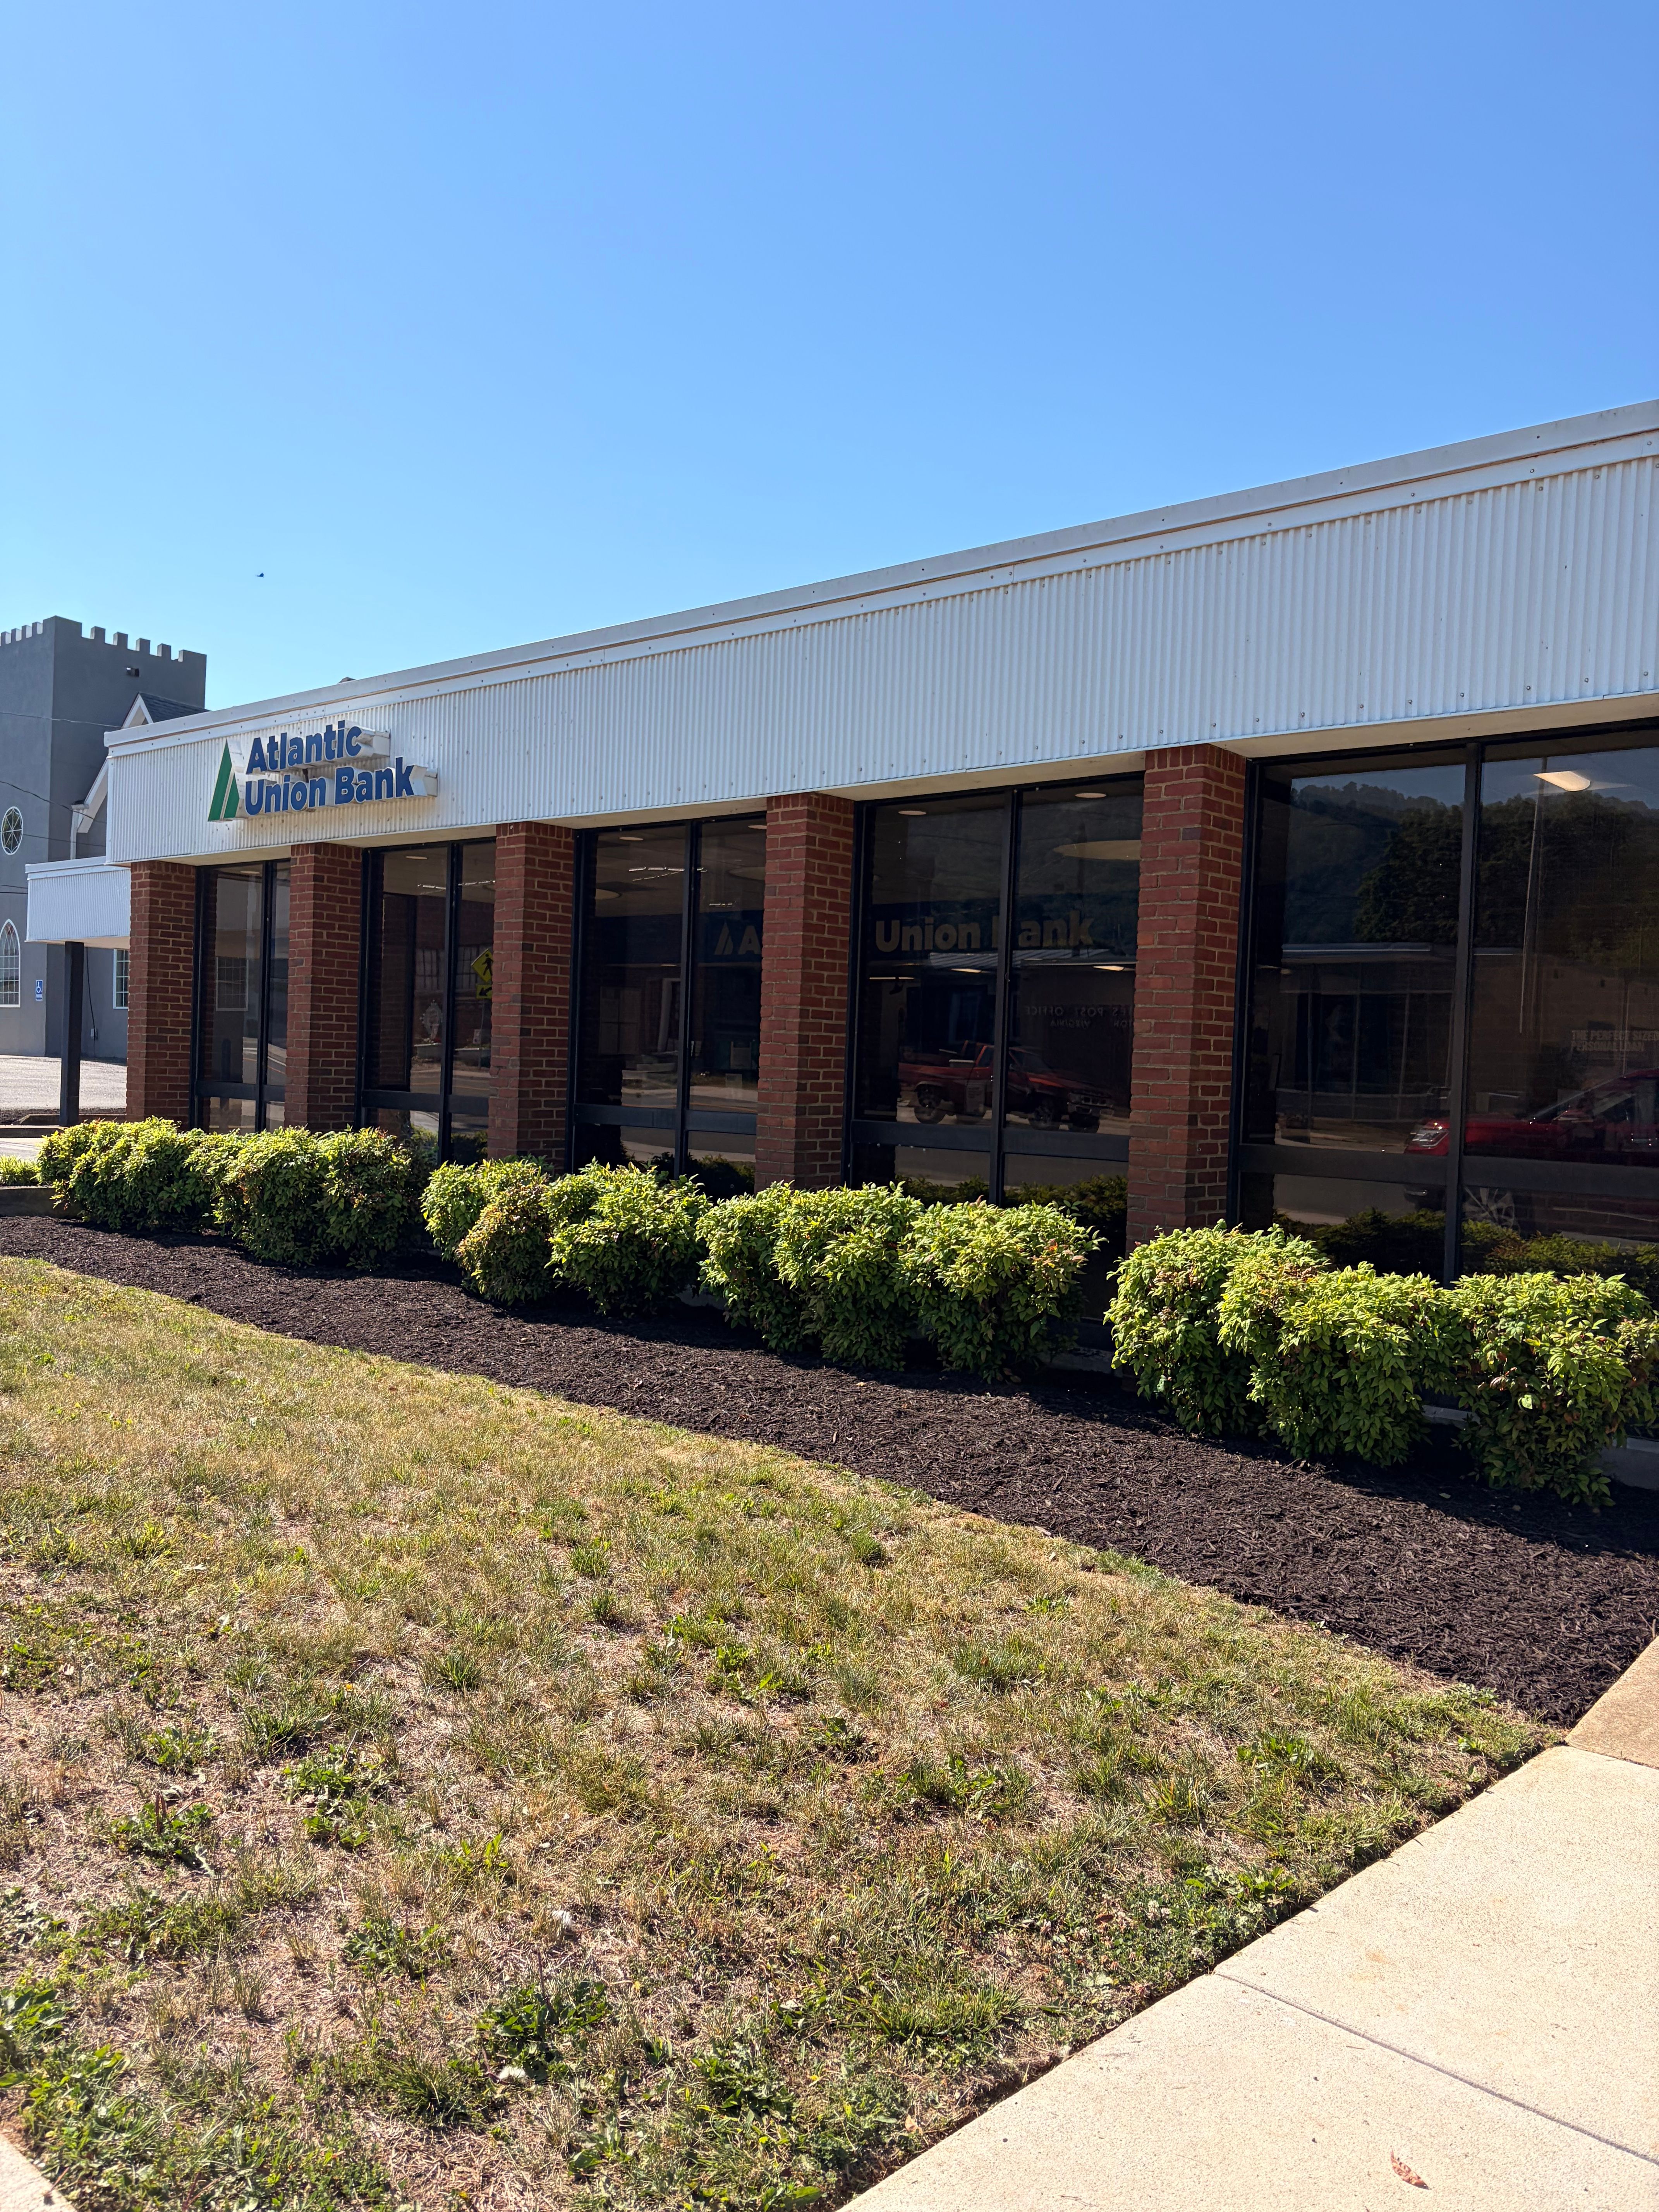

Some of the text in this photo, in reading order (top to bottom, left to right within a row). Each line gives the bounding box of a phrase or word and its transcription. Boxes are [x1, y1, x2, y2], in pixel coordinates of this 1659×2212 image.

[246, 720, 362, 774] Atlantic
[245, 756, 415, 815] Union Bank
[875, 917, 981, 952] Union
[1571, 1030, 1588, 1040] THE
[1590, 1030, 1630, 1041] PERFECT
[1571, 1041, 1644, 1052] PERSONAL LOAN
